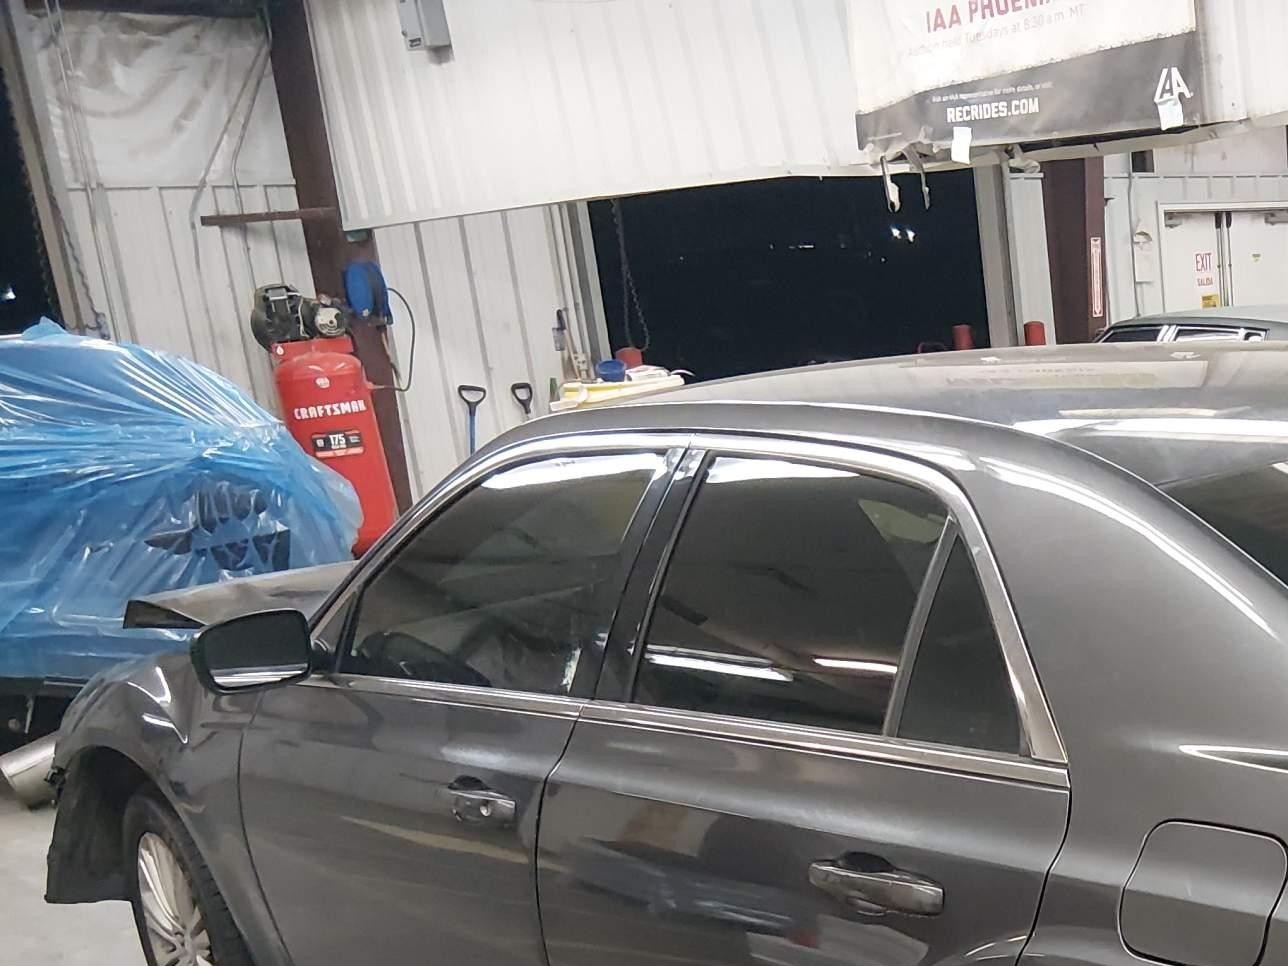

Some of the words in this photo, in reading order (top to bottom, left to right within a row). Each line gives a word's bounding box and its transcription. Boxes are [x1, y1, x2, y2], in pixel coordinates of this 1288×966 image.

[926, 4, 962, 33] IAA
[946, 97, 1040, 123] RECRIDES.COM
[1195, 252, 1212, 272] EXIT
[294, 399, 367, 420] CRAFTSMAN
[328, 433, 346, 445] 175
